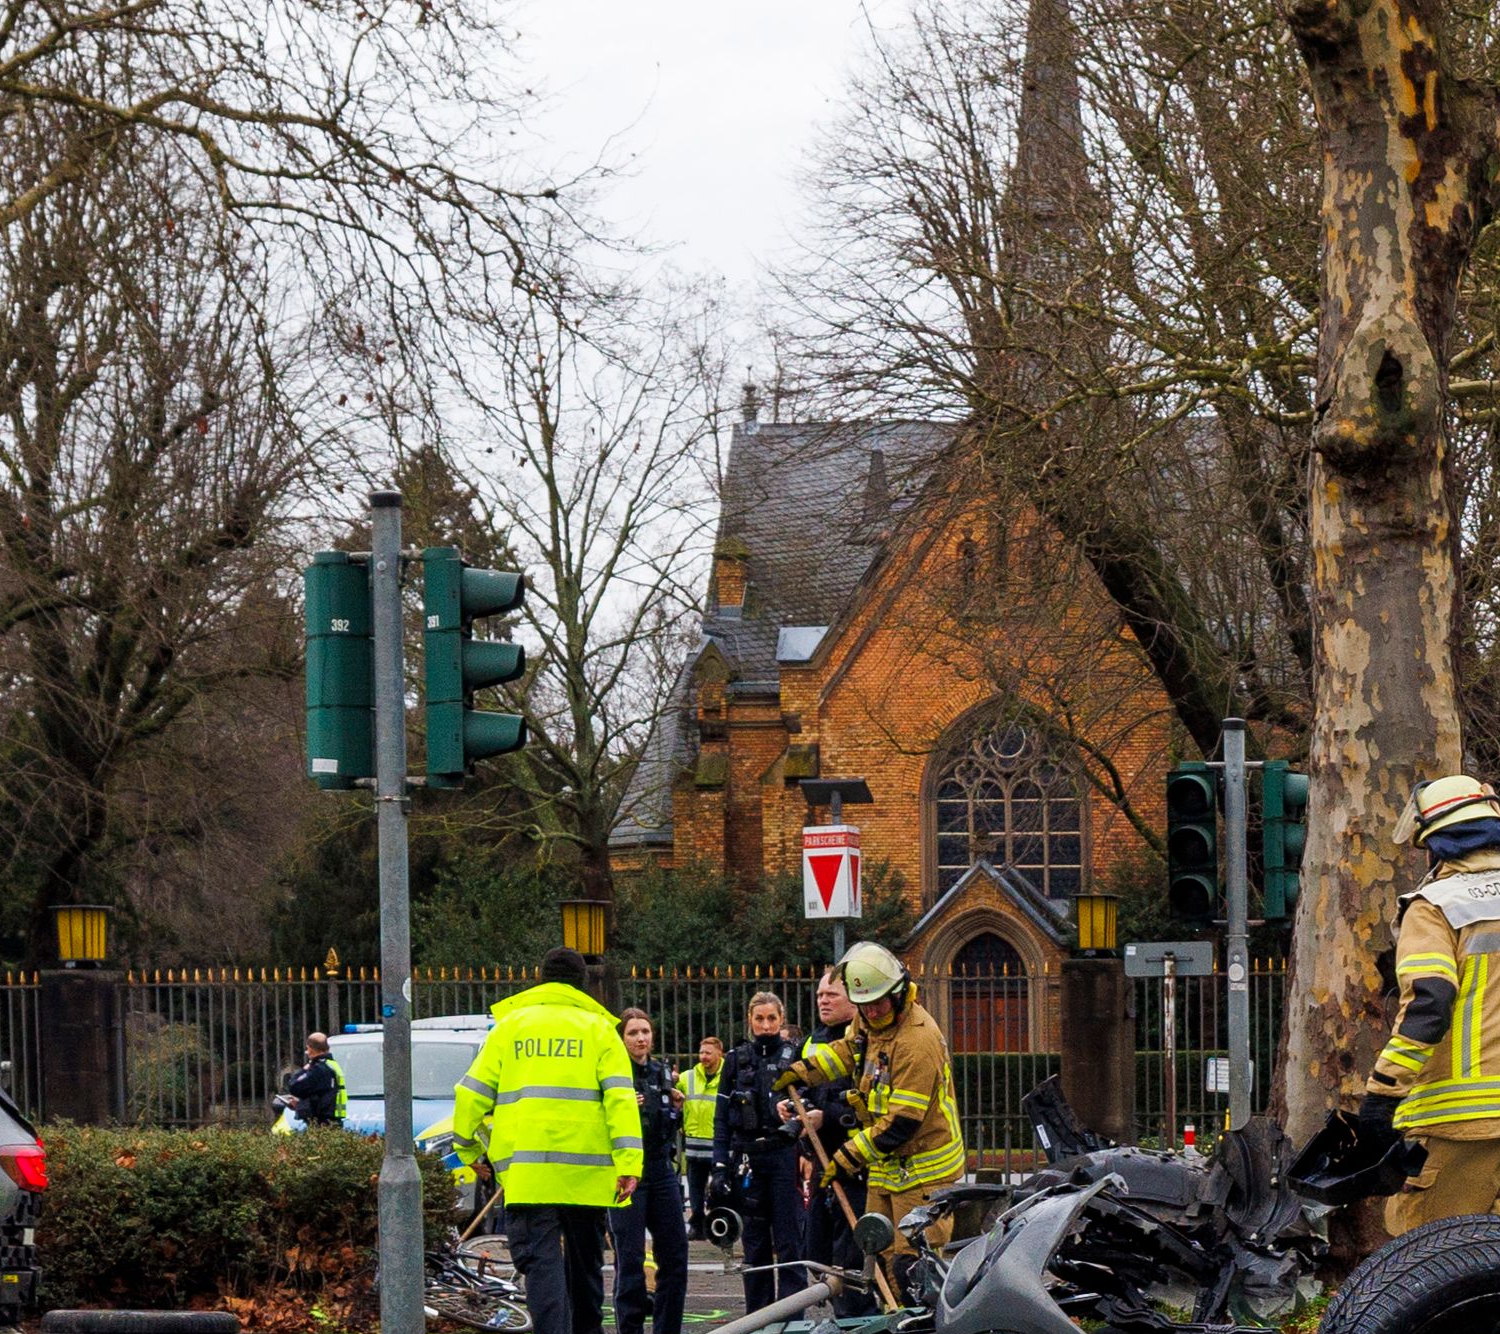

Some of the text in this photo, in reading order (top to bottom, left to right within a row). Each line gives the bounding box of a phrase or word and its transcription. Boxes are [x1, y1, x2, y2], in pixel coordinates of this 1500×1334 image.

[331, 618, 350, 632] 392
[427, 615, 440, 629] 391
[804, 833, 847, 847] PARKSCHEINE
[854, 977, 862, 988] 3
[514, 1038, 583, 1060] POLIZEI
